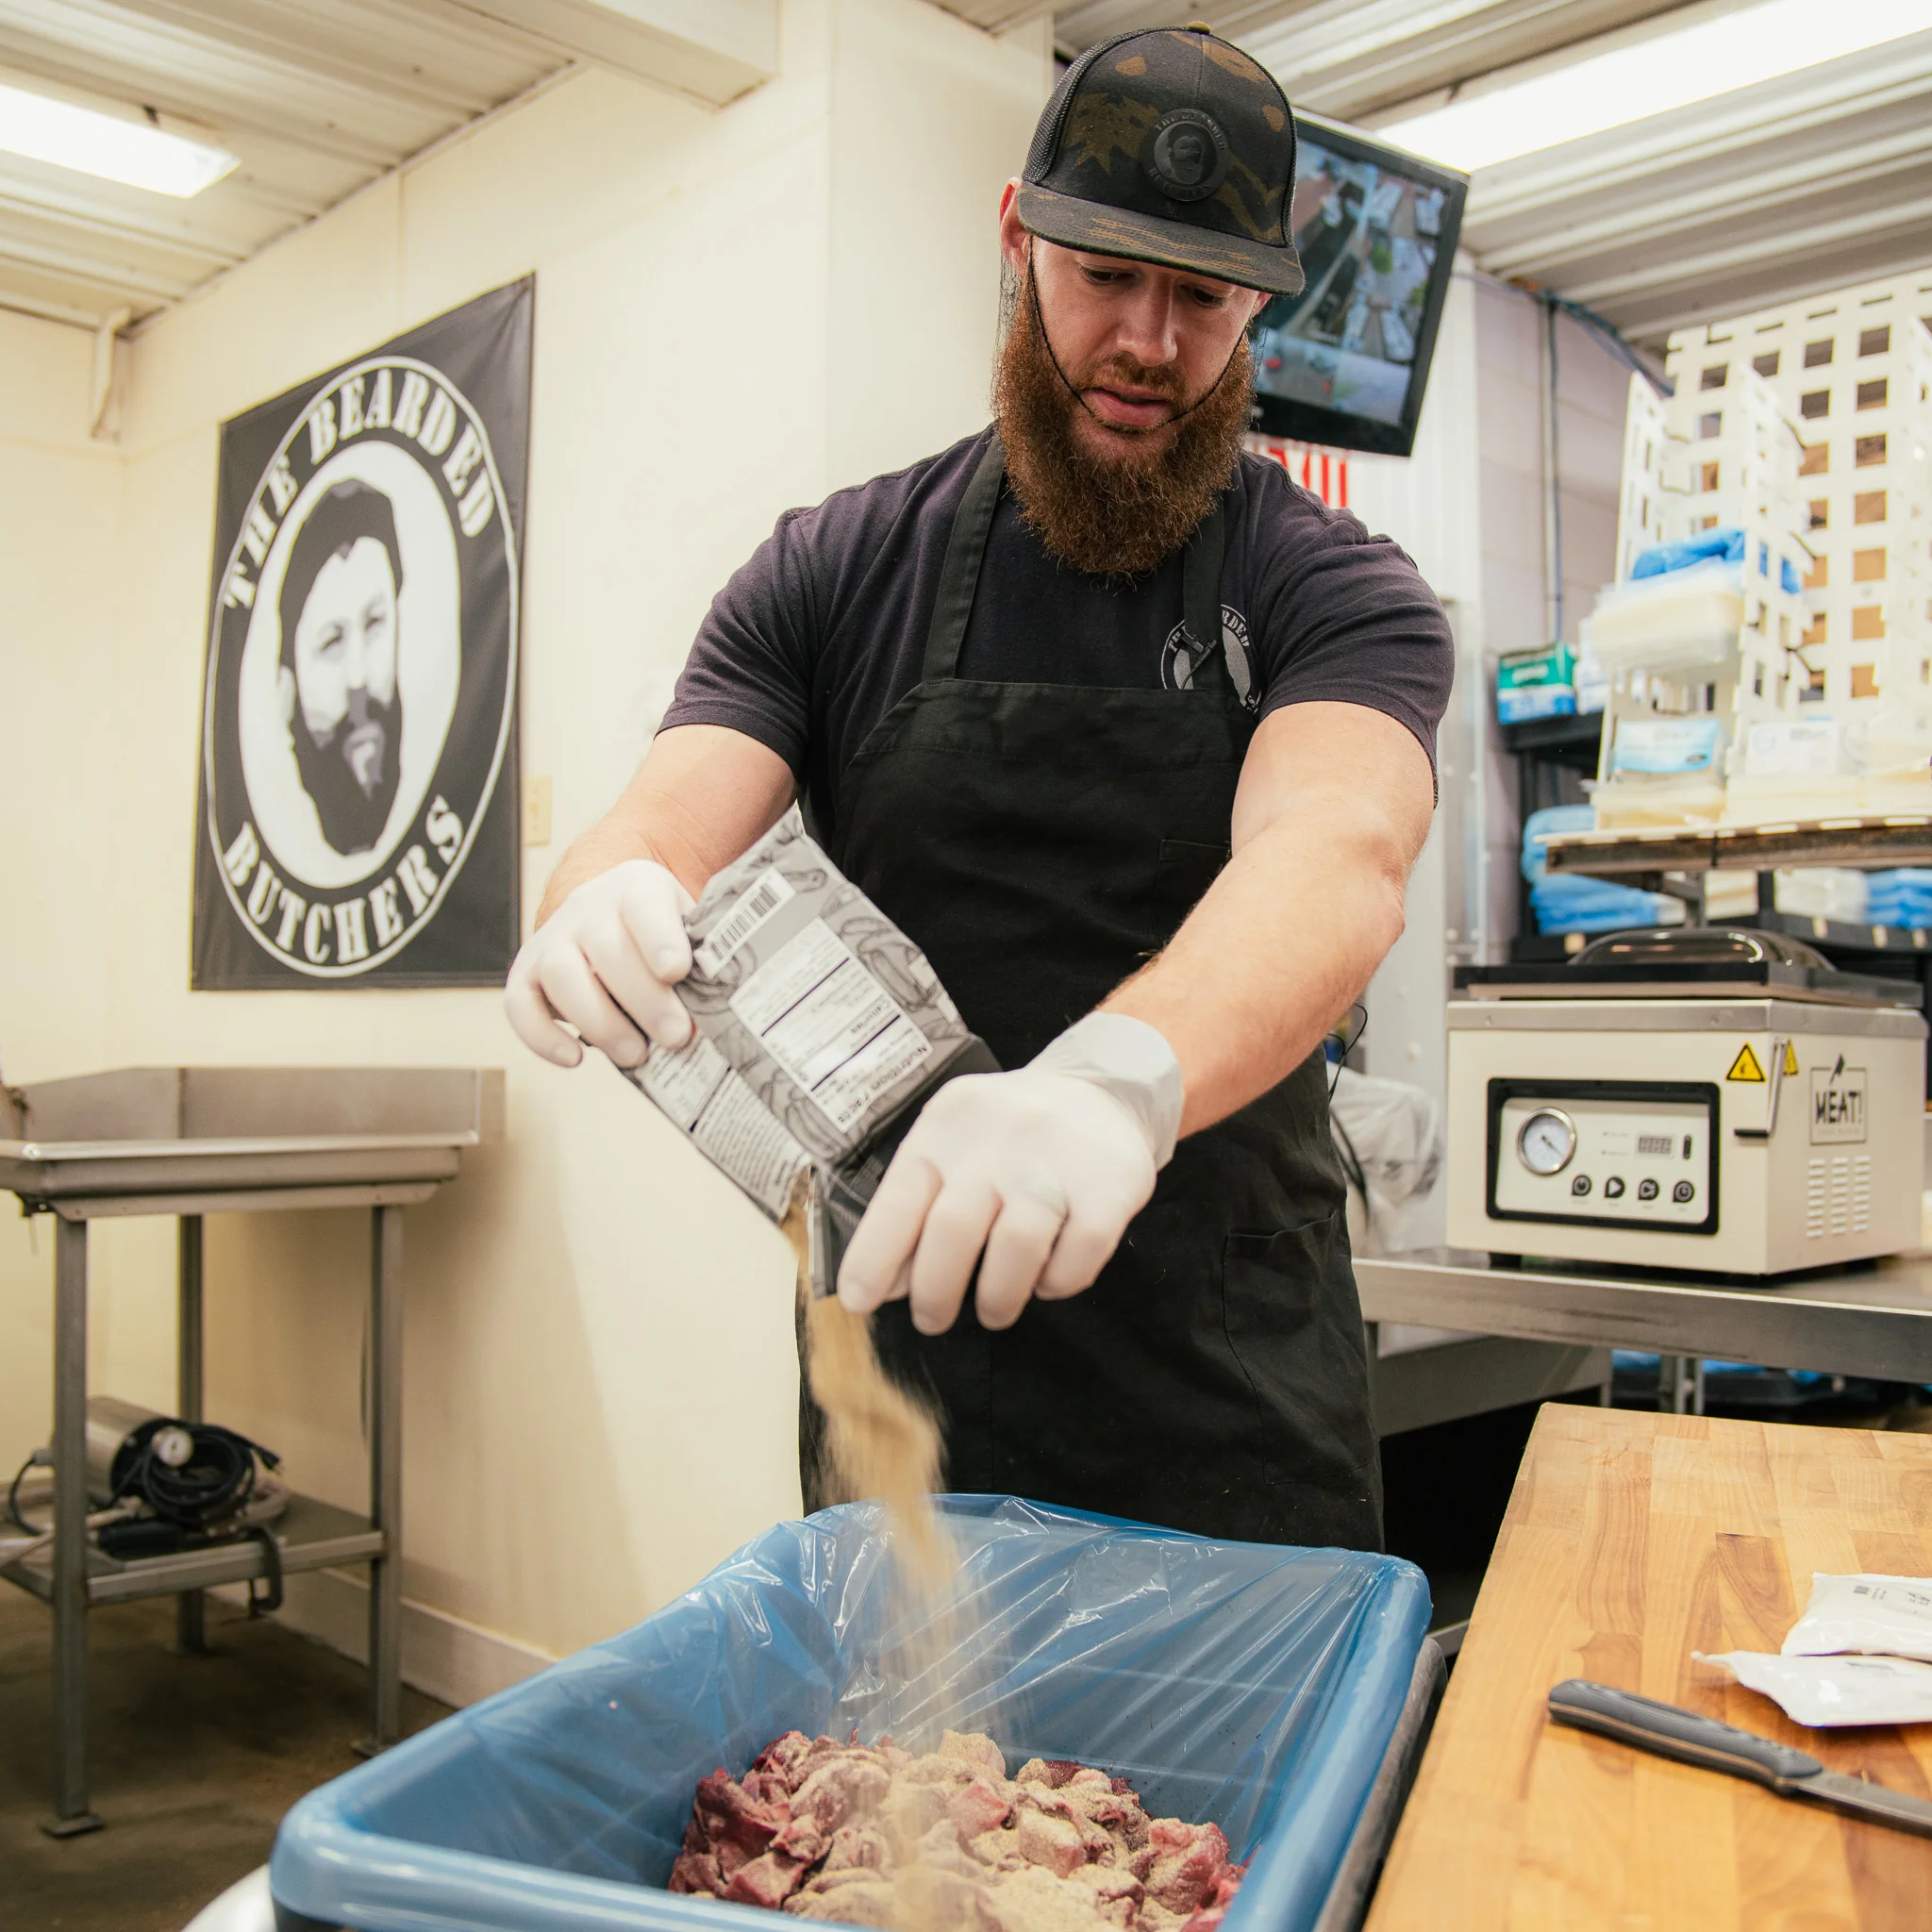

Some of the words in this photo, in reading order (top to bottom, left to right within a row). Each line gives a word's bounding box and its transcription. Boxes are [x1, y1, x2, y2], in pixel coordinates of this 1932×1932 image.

[224, 454, 298, 609] THE
[307, 368, 494, 538] BEARDED
[224, 794, 464, 964] BUTCHERS
[871, 1044, 929, 1091] Nutrition
